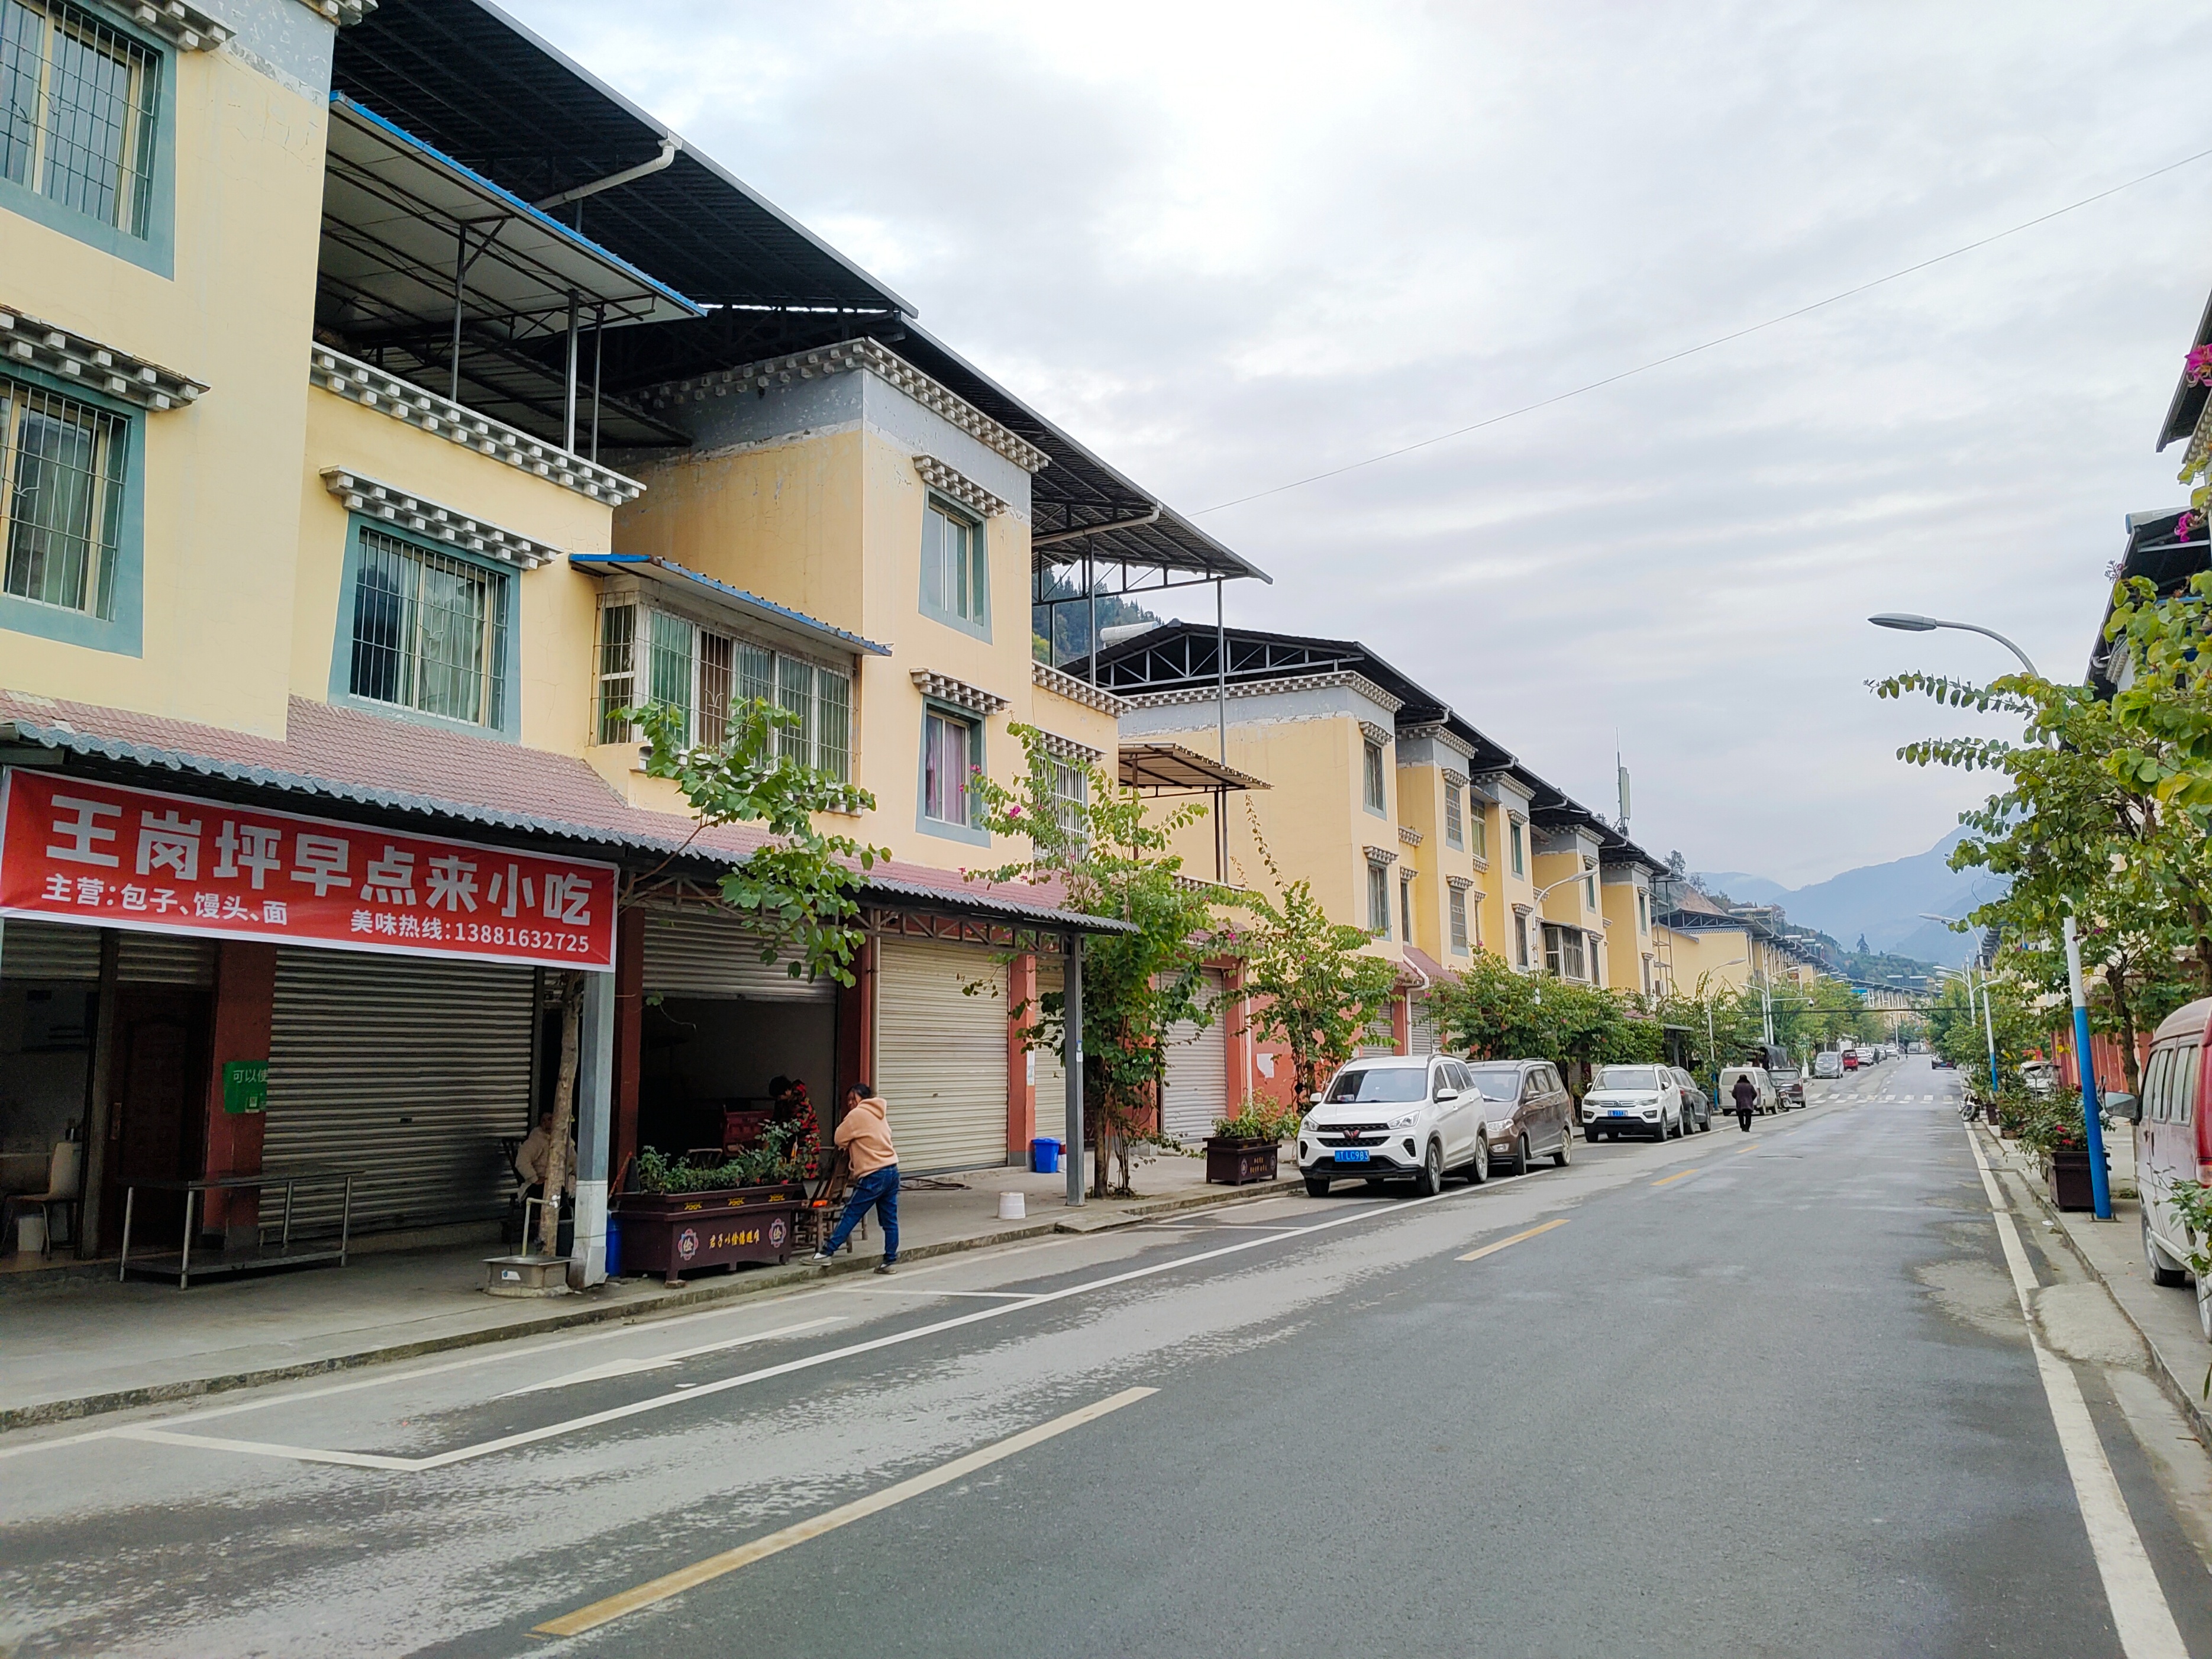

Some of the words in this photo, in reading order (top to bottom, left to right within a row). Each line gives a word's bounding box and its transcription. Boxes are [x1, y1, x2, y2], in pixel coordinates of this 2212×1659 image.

[46, 795, 593, 927] 王岗坪早点来小吃
[351, 909, 589, 953] 美味热线:13881632725
